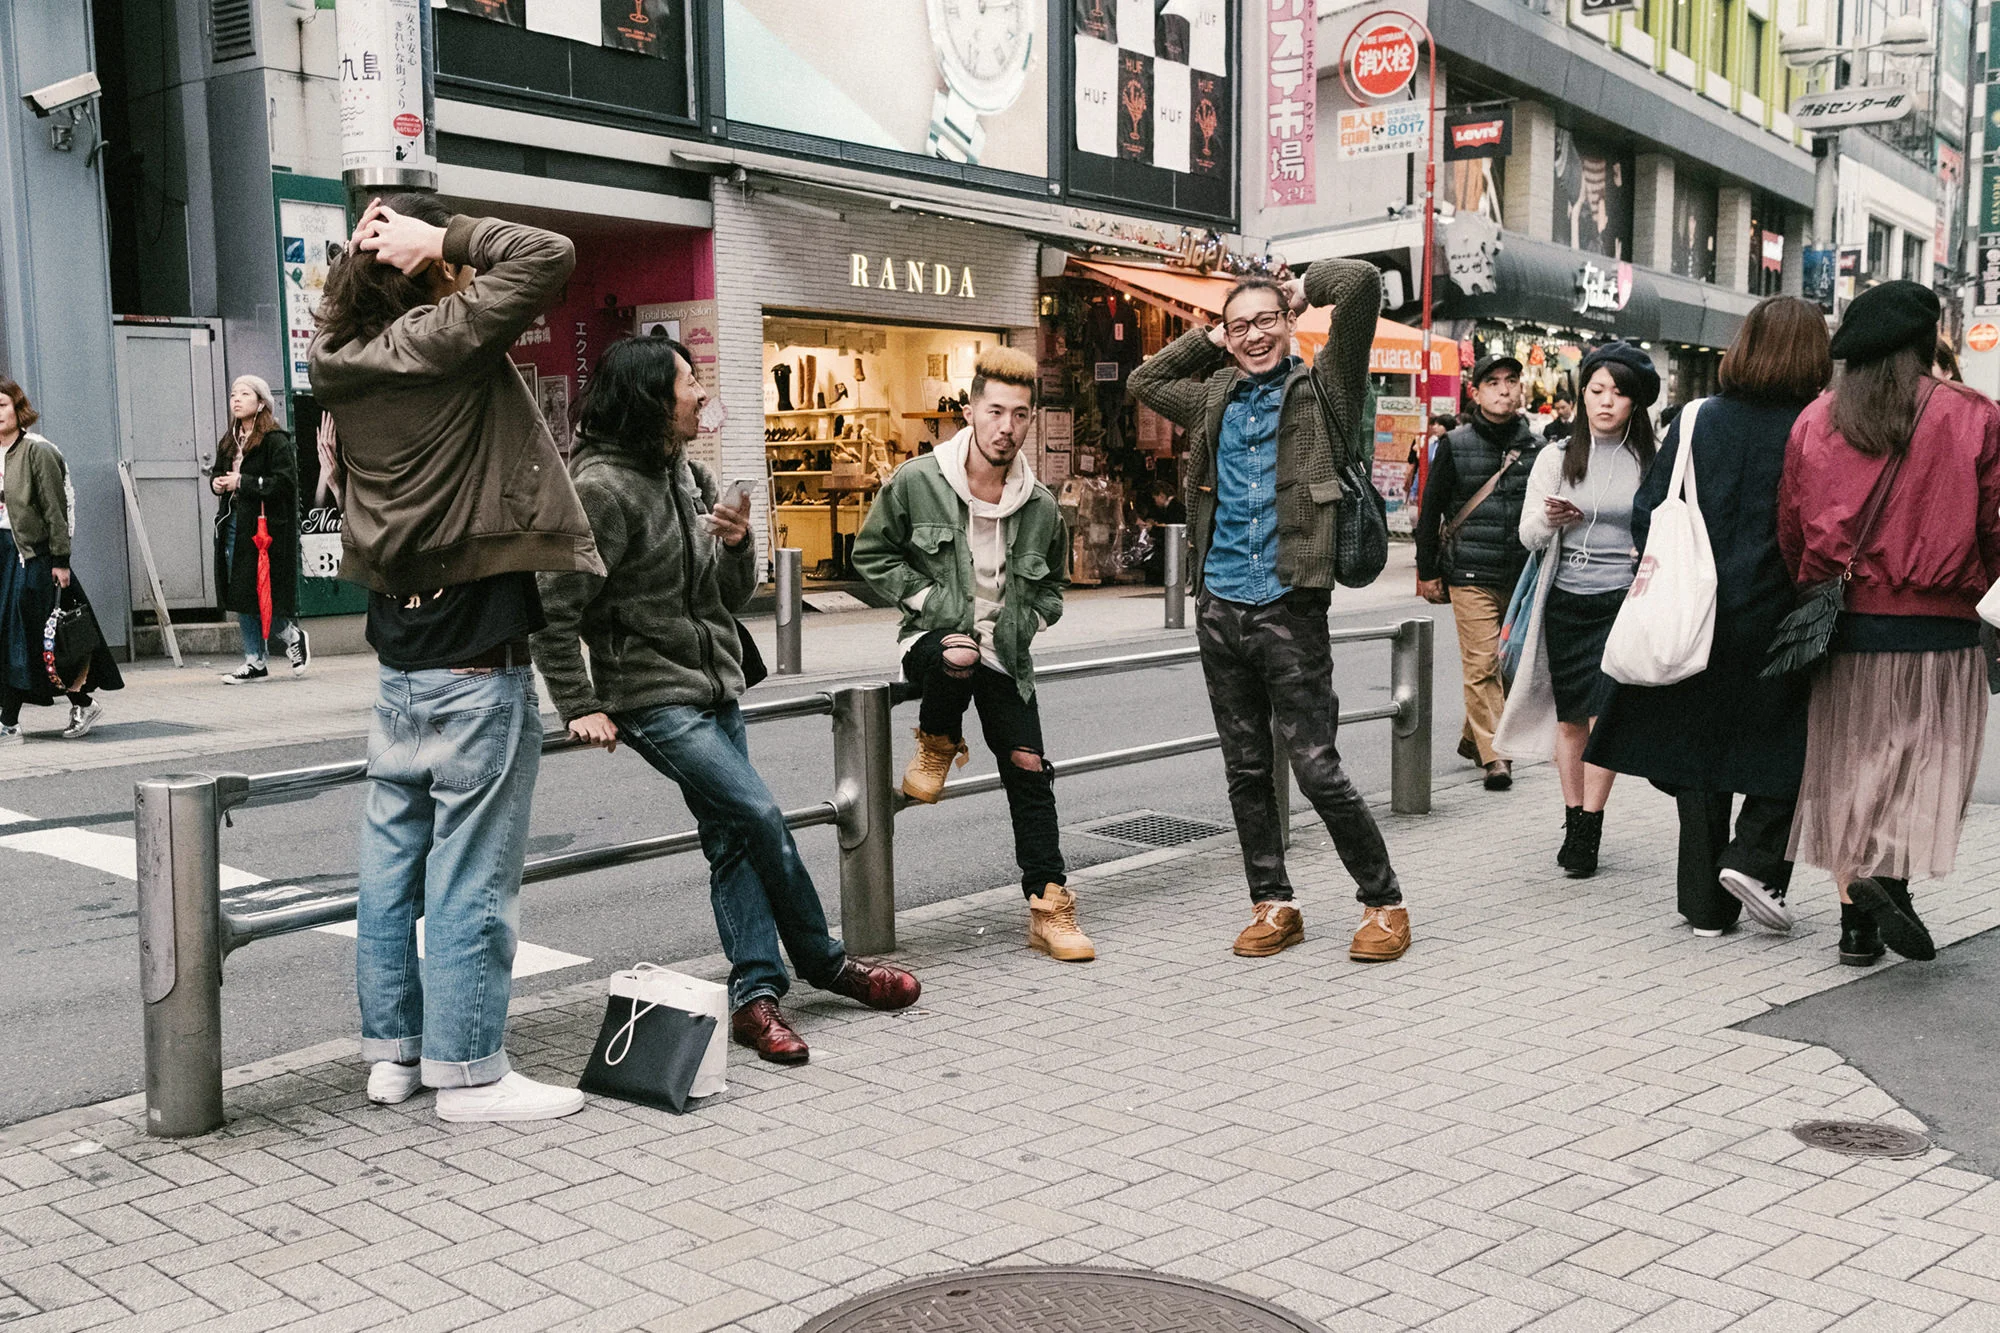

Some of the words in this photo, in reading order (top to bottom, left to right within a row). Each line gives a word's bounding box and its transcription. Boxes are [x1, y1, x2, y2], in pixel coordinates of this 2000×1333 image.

[394, 21, 406, 109] きれいな街づくり
[1126, 58, 1144, 73] HUF
[1358, 43, 1412, 77] 消火栓
[1084, 87, 1108, 105] HUF
[1198, 79, 1214, 93] HUF
[1160, 106, 1183, 123] HUF
[1796, 94, 1907, 117] 渋谷センター街
[1388, 120, 1425, 137] 8017
[850, 253, 976, 298] RANDA
[641, 307, 660, 320] Total
[661, 308, 689, 320] Beauty
[690, 306, 712, 317] Salon
[575, 322, 588, 390] エクステ
[1369, 348, 1442, 370] aruara.cm
